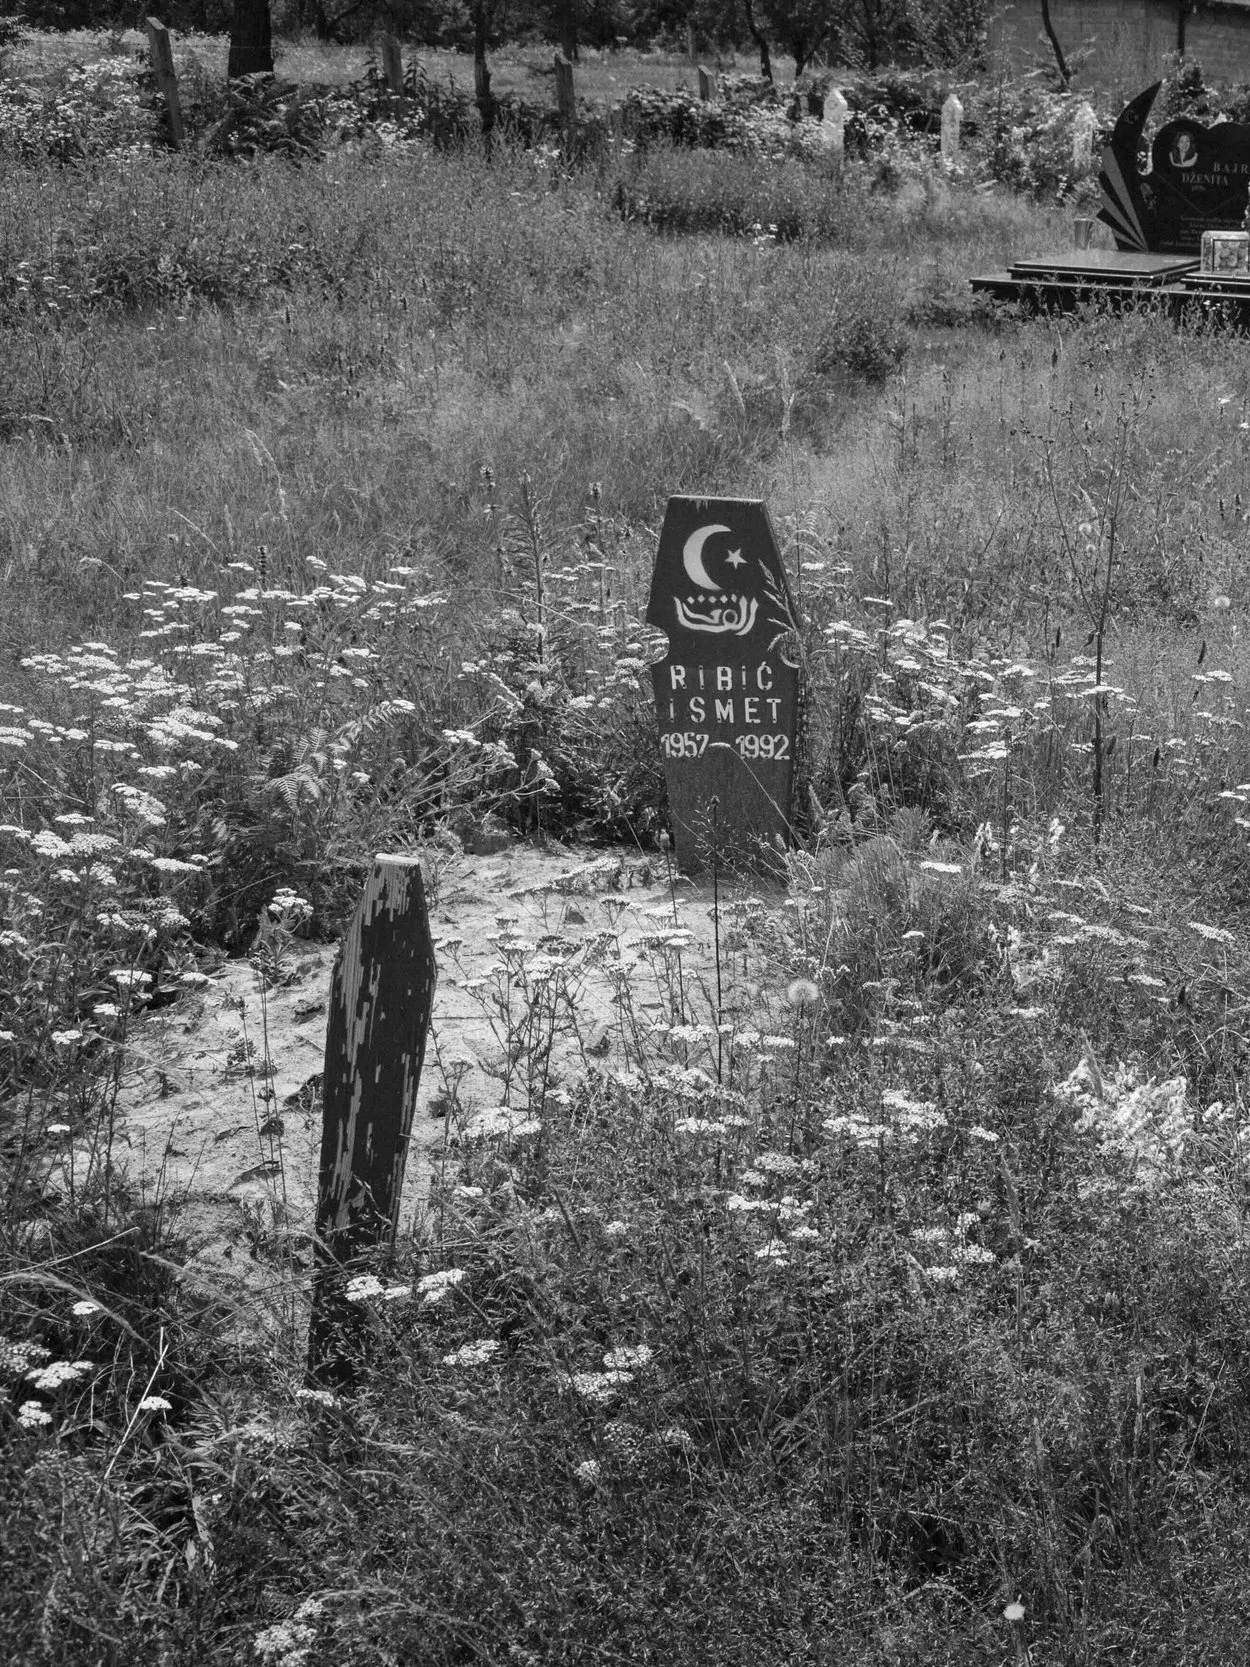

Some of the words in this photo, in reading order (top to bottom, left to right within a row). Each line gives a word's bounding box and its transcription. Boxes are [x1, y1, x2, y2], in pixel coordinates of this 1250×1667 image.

[1182, 171, 1229, 186] DŽENITA
[670, 661, 773, 691] RIBIĆ
[669, 696, 782, 723] ISMET
[660, 732, 710, 758] 1957
[735, 734, 790, 760] 1992
